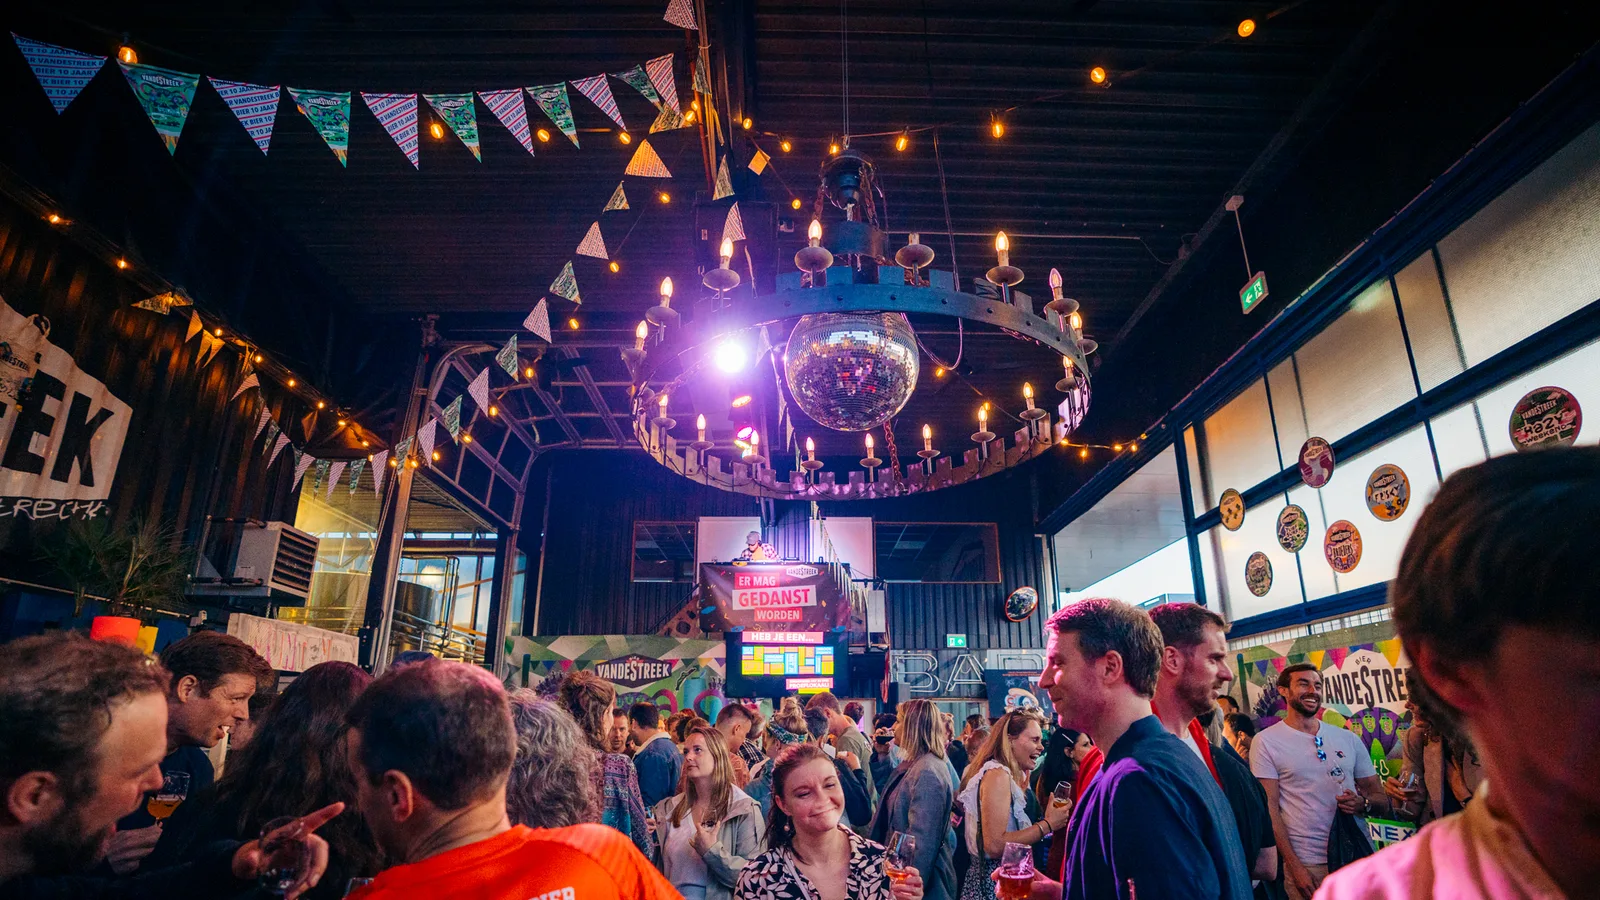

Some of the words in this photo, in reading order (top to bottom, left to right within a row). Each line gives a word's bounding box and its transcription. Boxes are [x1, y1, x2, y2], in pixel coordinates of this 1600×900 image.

[38, 58, 96, 66] VANDESTREEK
[142, 74, 180, 86] VANDESTREEK
[234, 93, 275, 104] VANDESTREEK
[384, 102, 414, 120] VANDESTREEK
[0, 369, 114, 487] EK
[739, 576, 750, 586] ER
[753, 576, 776, 586] MAG
[739, 588, 810, 607] GEDANST
[757, 610, 800, 620] WORDEN
[1355, 656, 1372, 666] BIER
[597, 660, 670, 681] VANDESTREEK
[1324, 665, 1408, 710] ANDESTRE
[1371, 824, 1414, 841] NEX
